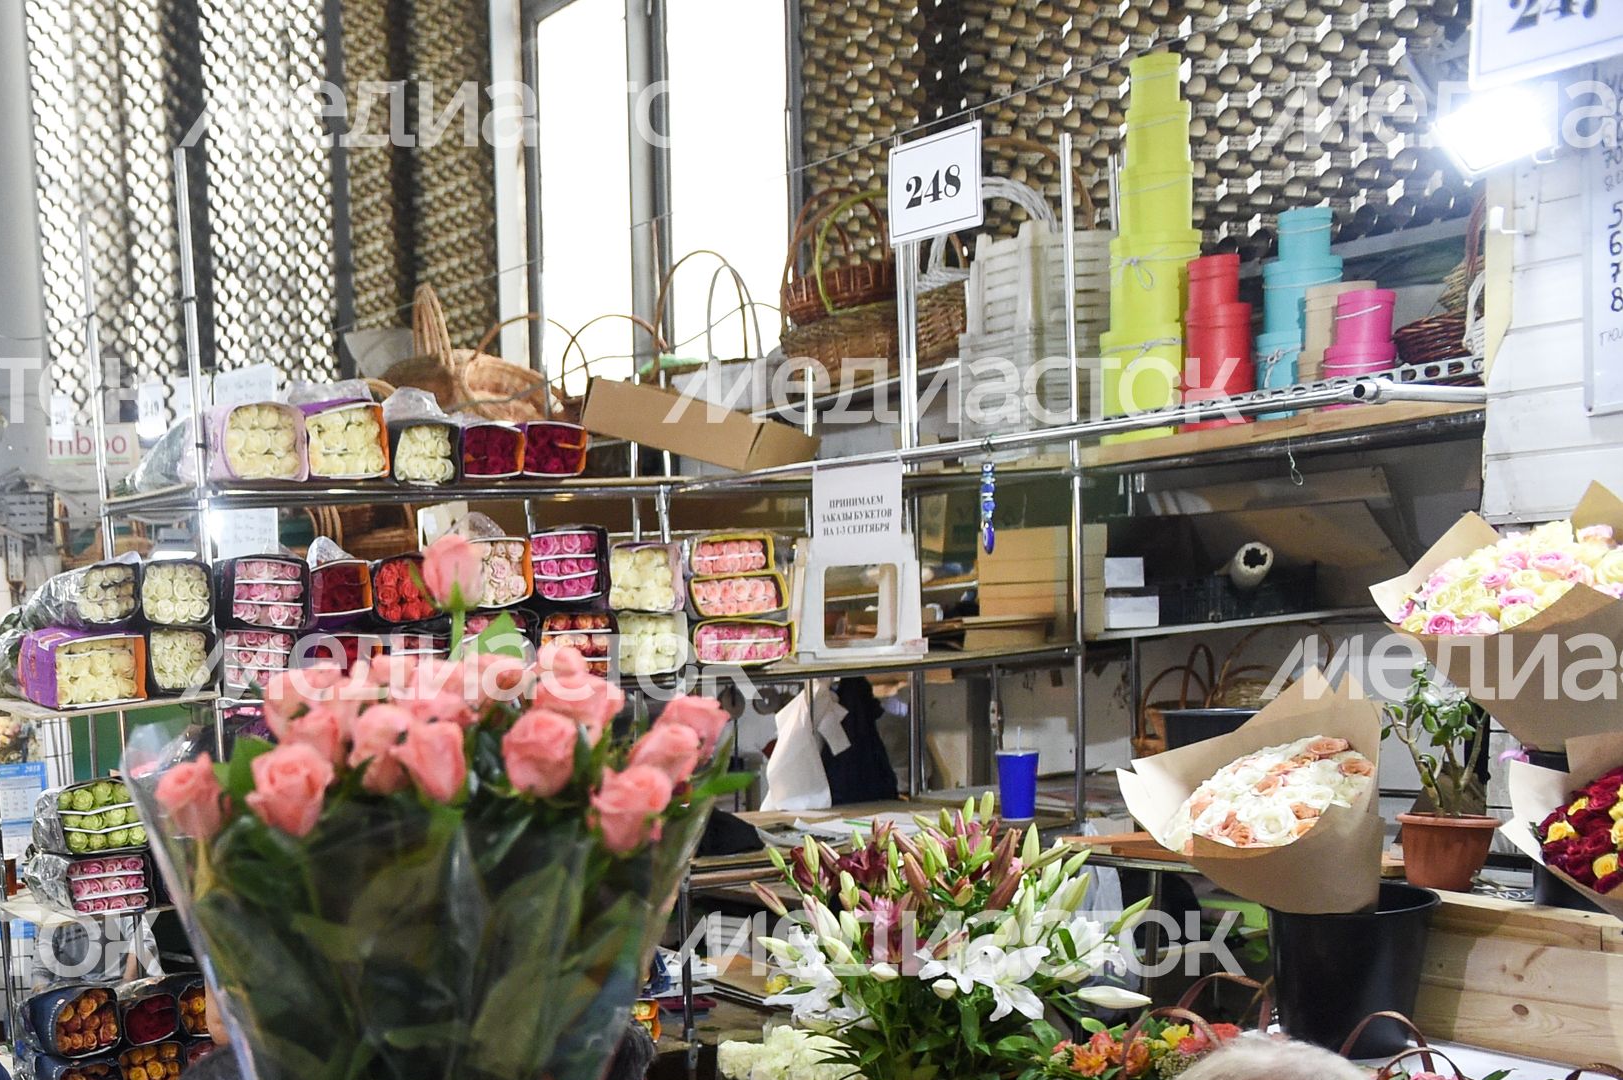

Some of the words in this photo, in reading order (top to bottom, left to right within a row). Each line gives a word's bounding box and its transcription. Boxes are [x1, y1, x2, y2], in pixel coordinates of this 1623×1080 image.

[905, 162, 963, 210] 248
[49, 430, 127, 456] mbo
[829, 494, 884, 509] ПРИНИМАЕМ
[822, 512, 853, 523] ЗАКАЗЫ
[853, 508, 892, 521] БУКЕТОВ
[823, 527, 834, 537] НА
[836, 526, 846, 536] 1-3
[847, 522, 890, 535] СЕНТЯБРЯ
